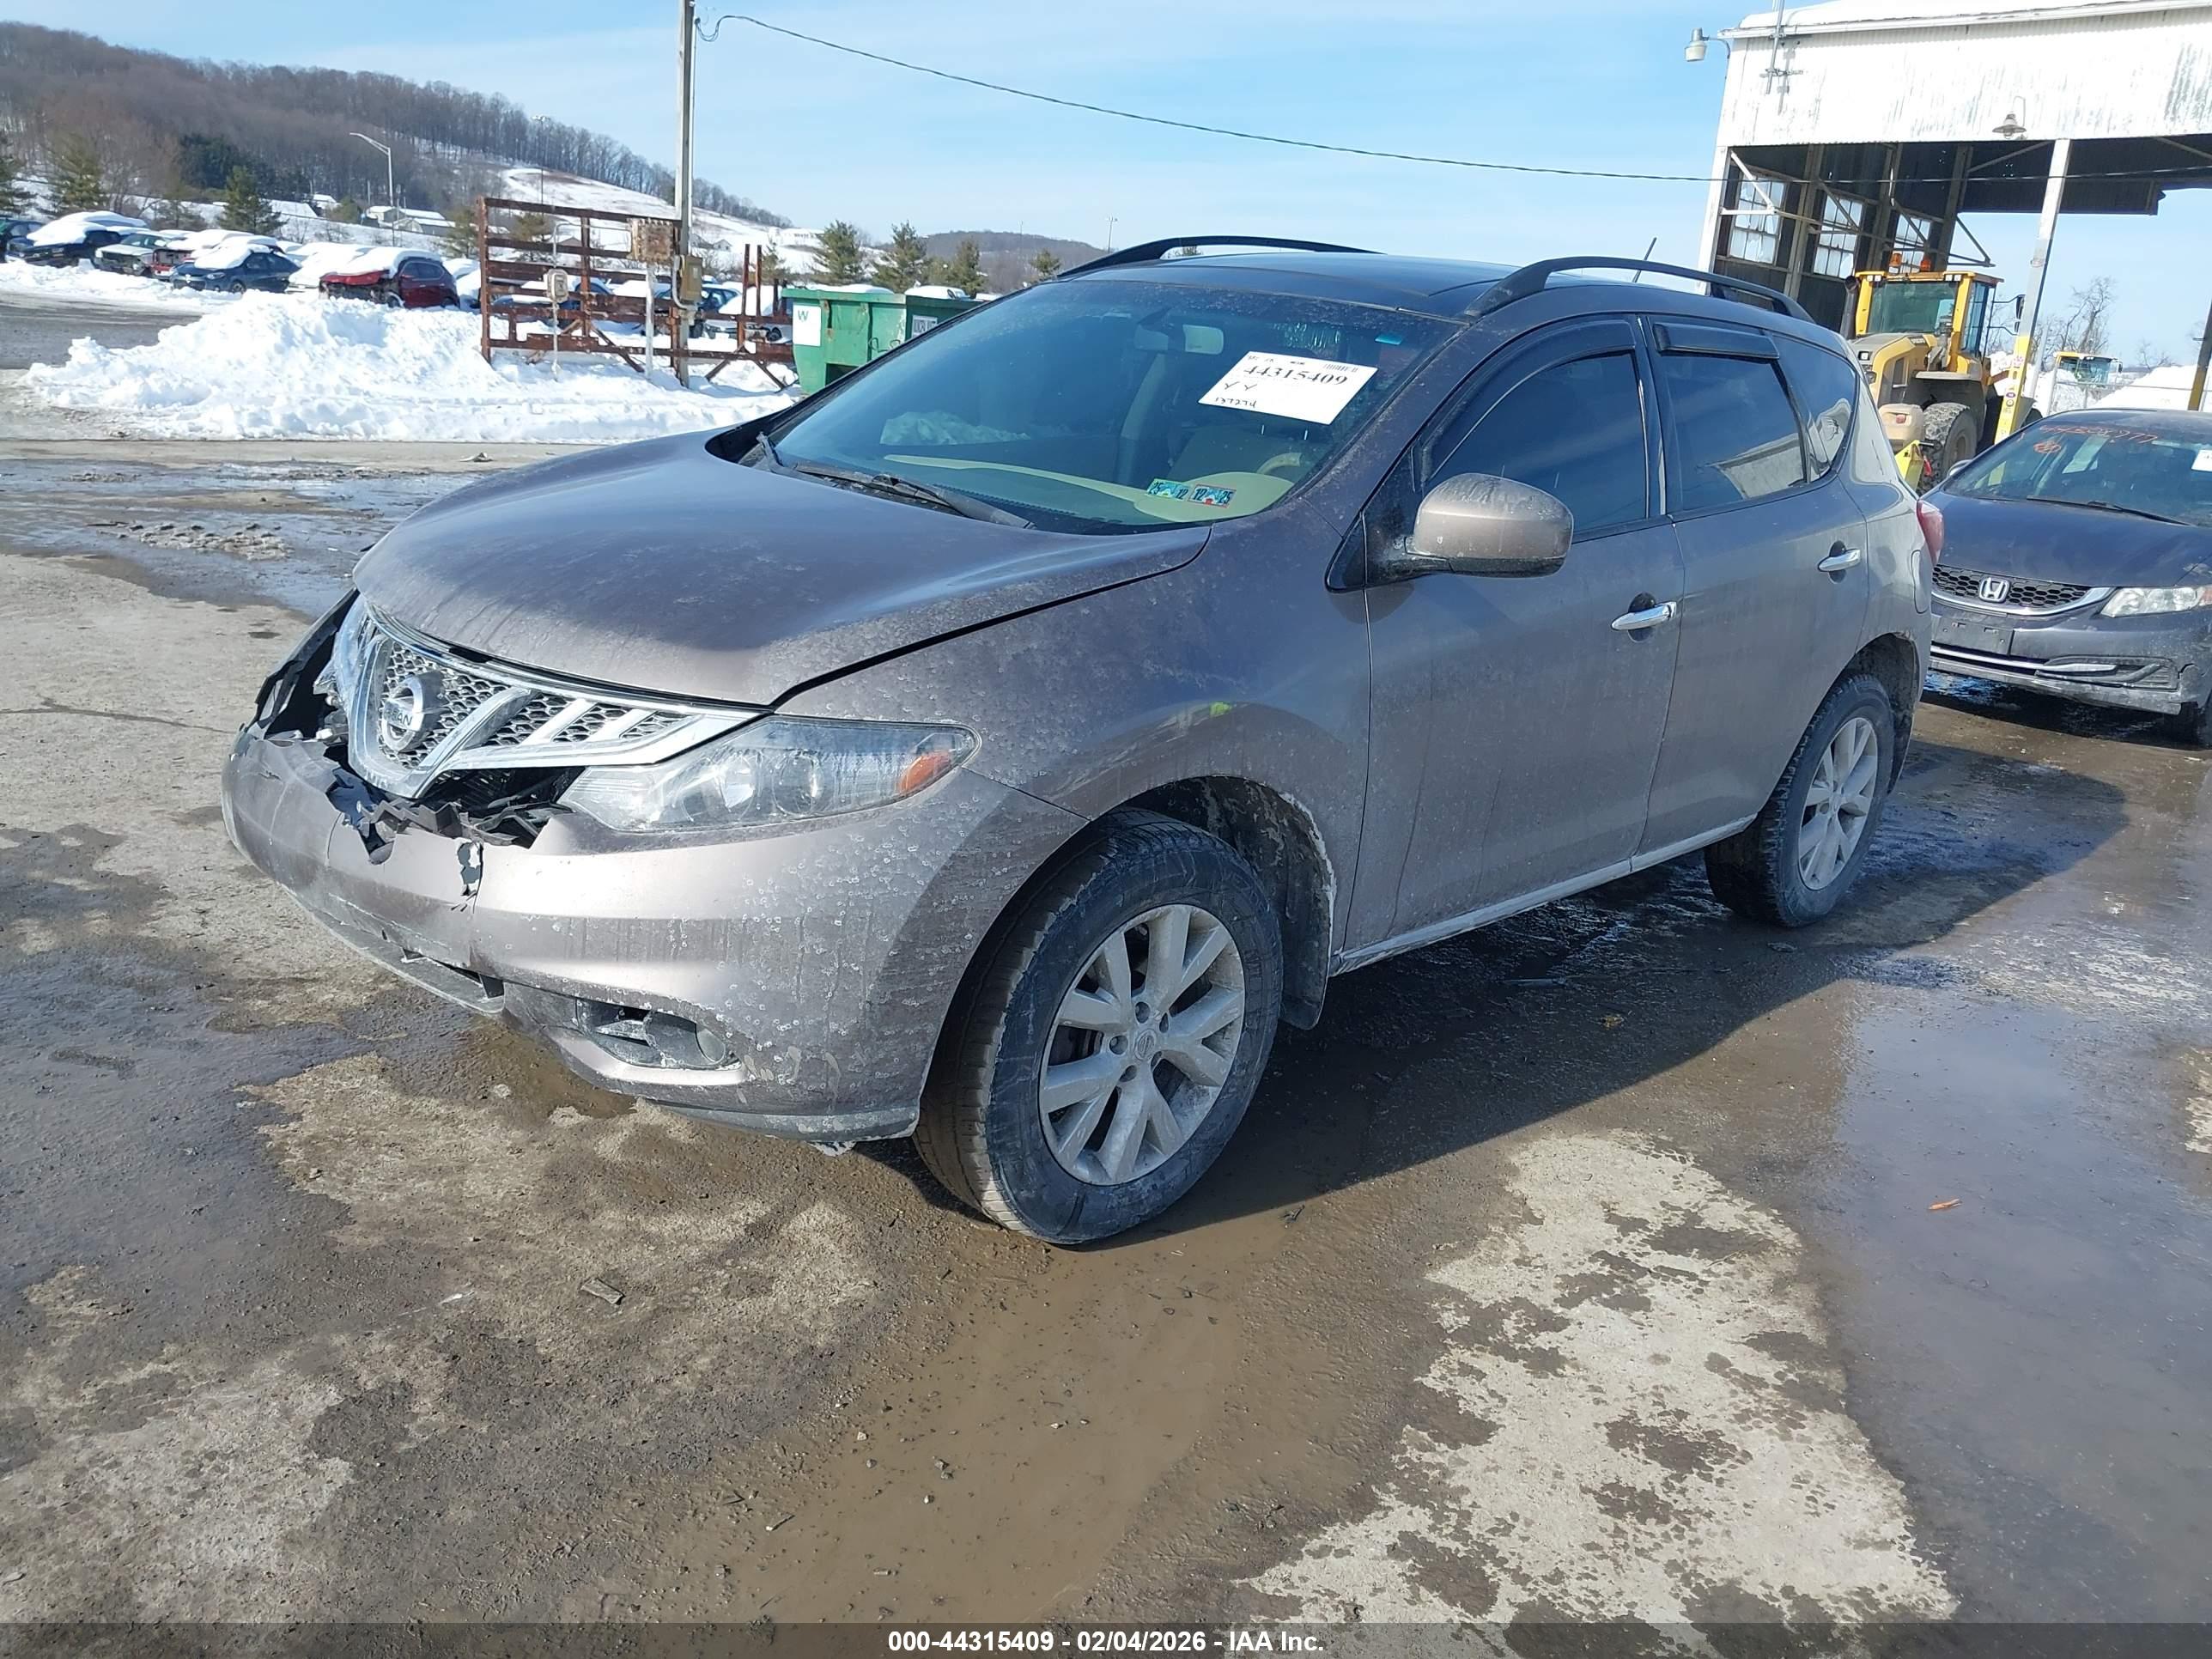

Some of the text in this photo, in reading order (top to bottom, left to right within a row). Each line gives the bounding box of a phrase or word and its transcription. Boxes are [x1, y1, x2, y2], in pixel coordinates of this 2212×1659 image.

[1243, 365, 1348, 386] 44315409
[1176, 489, 1189, 500] 12
[1193, 488, 1234, 504] 12 25
